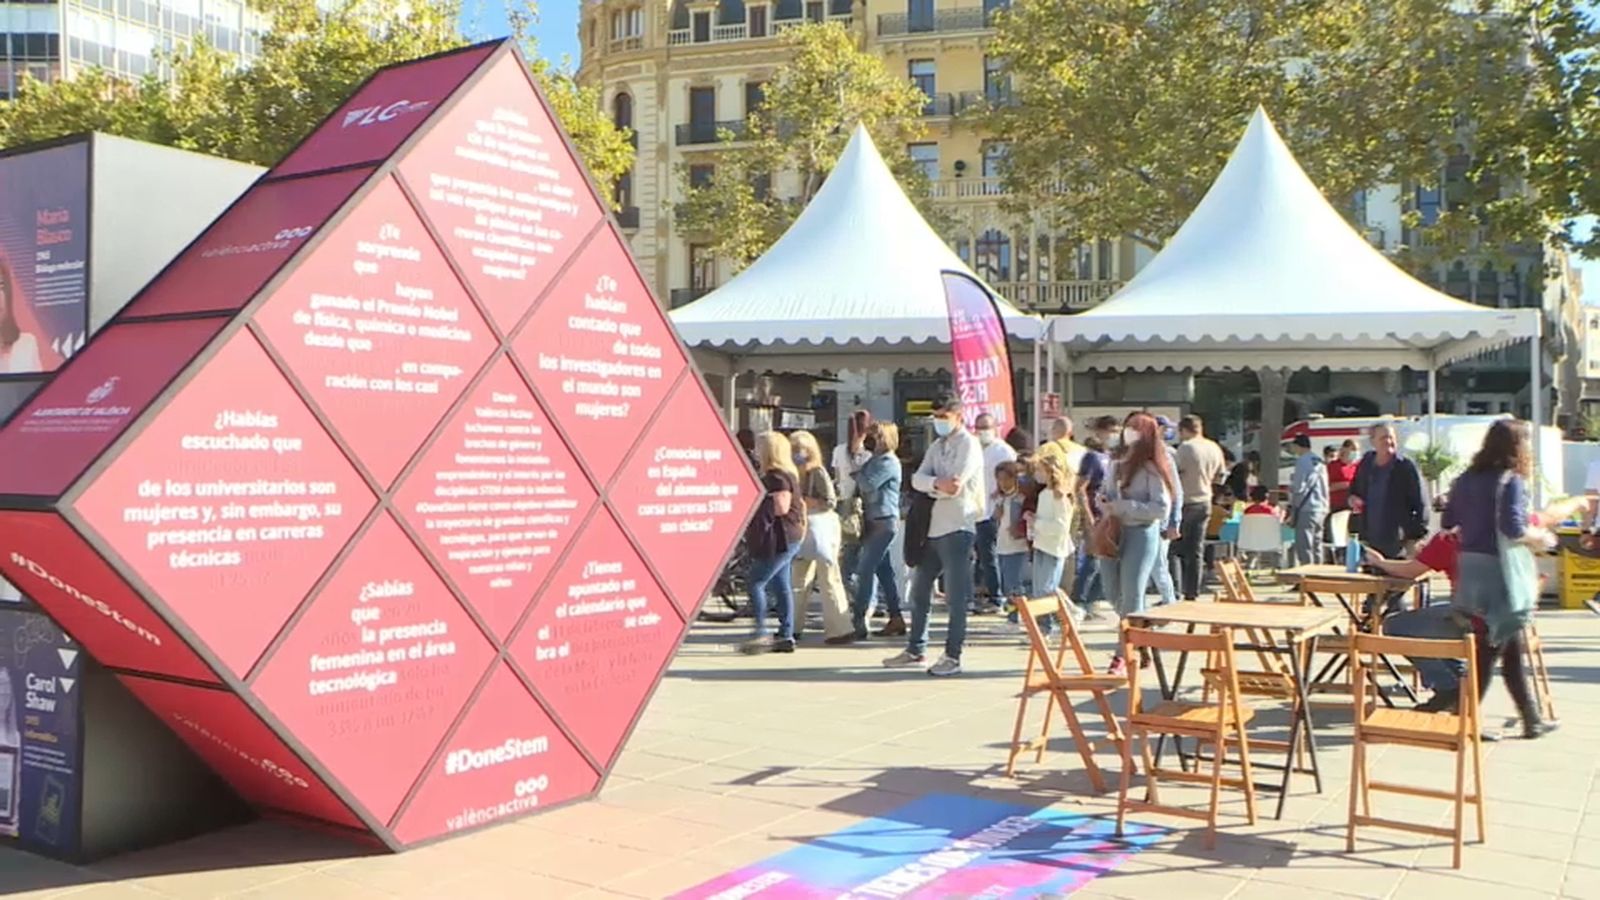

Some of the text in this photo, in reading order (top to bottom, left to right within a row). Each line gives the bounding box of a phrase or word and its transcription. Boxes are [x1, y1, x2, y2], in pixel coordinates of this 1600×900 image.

[357, 240, 421, 262] sorprende
[353, 260, 379, 275] que
[596, 274, 618, 293] ¿Te
[310, 293, 459, 322] ganado el Premio Nobel
[293, 310, 311, 325] de
[407, 324, 417, 335] o
[418, 323, 473, 342] medicina
[567, 316, 642, 338] contado que
[304, 331, 372, 353] desde que
[613, 340, 662, 359] de todos
[539, 352, 662, 379] los investigadores en
[325, 374, 439, 394] ración con los casi
[562, 377, 641, 398] el mundo son
[214, 410, 279, 431] ¿Habías
[575, 400, 630, 420] mujeres?
[181, 433, 303, 454] escuchado que
[138, 479, 337, 497] de los universitarios son
[123, 501, 342, 525] mujeres y, sin embargo, su
[667, 502, 707, 515] carreras
[708, 499, 733, 513] STEM
[147, 525, 324, 550] presencia en carreras
[660, 522, 677, 534] son
[169, 550, 241, 568] técnicas
[582, 560, 623, 579] ¿Tienes
[359, 579, 414, 602] ¿Sabías
[621, 579, 635, 592] en
[10, 551, 162, 646] #DoneStem
[555, 596, 647, 618] el calendario que
[351, 606, 380, 626] que
[361, 626, 376, 643] la
[378, 619, 448, 646] presencia
[537, 625, 550, 641] el
[309, 640, 456, 673] femenina en el área
[557, 641, 569, 657] el
[25, 672, 56, 694] Carol
[309, 670, 397, 696] tecnológica
[25, 690, 57, 713] Shaw
[445, 736, 549, 776] #DoneStem
